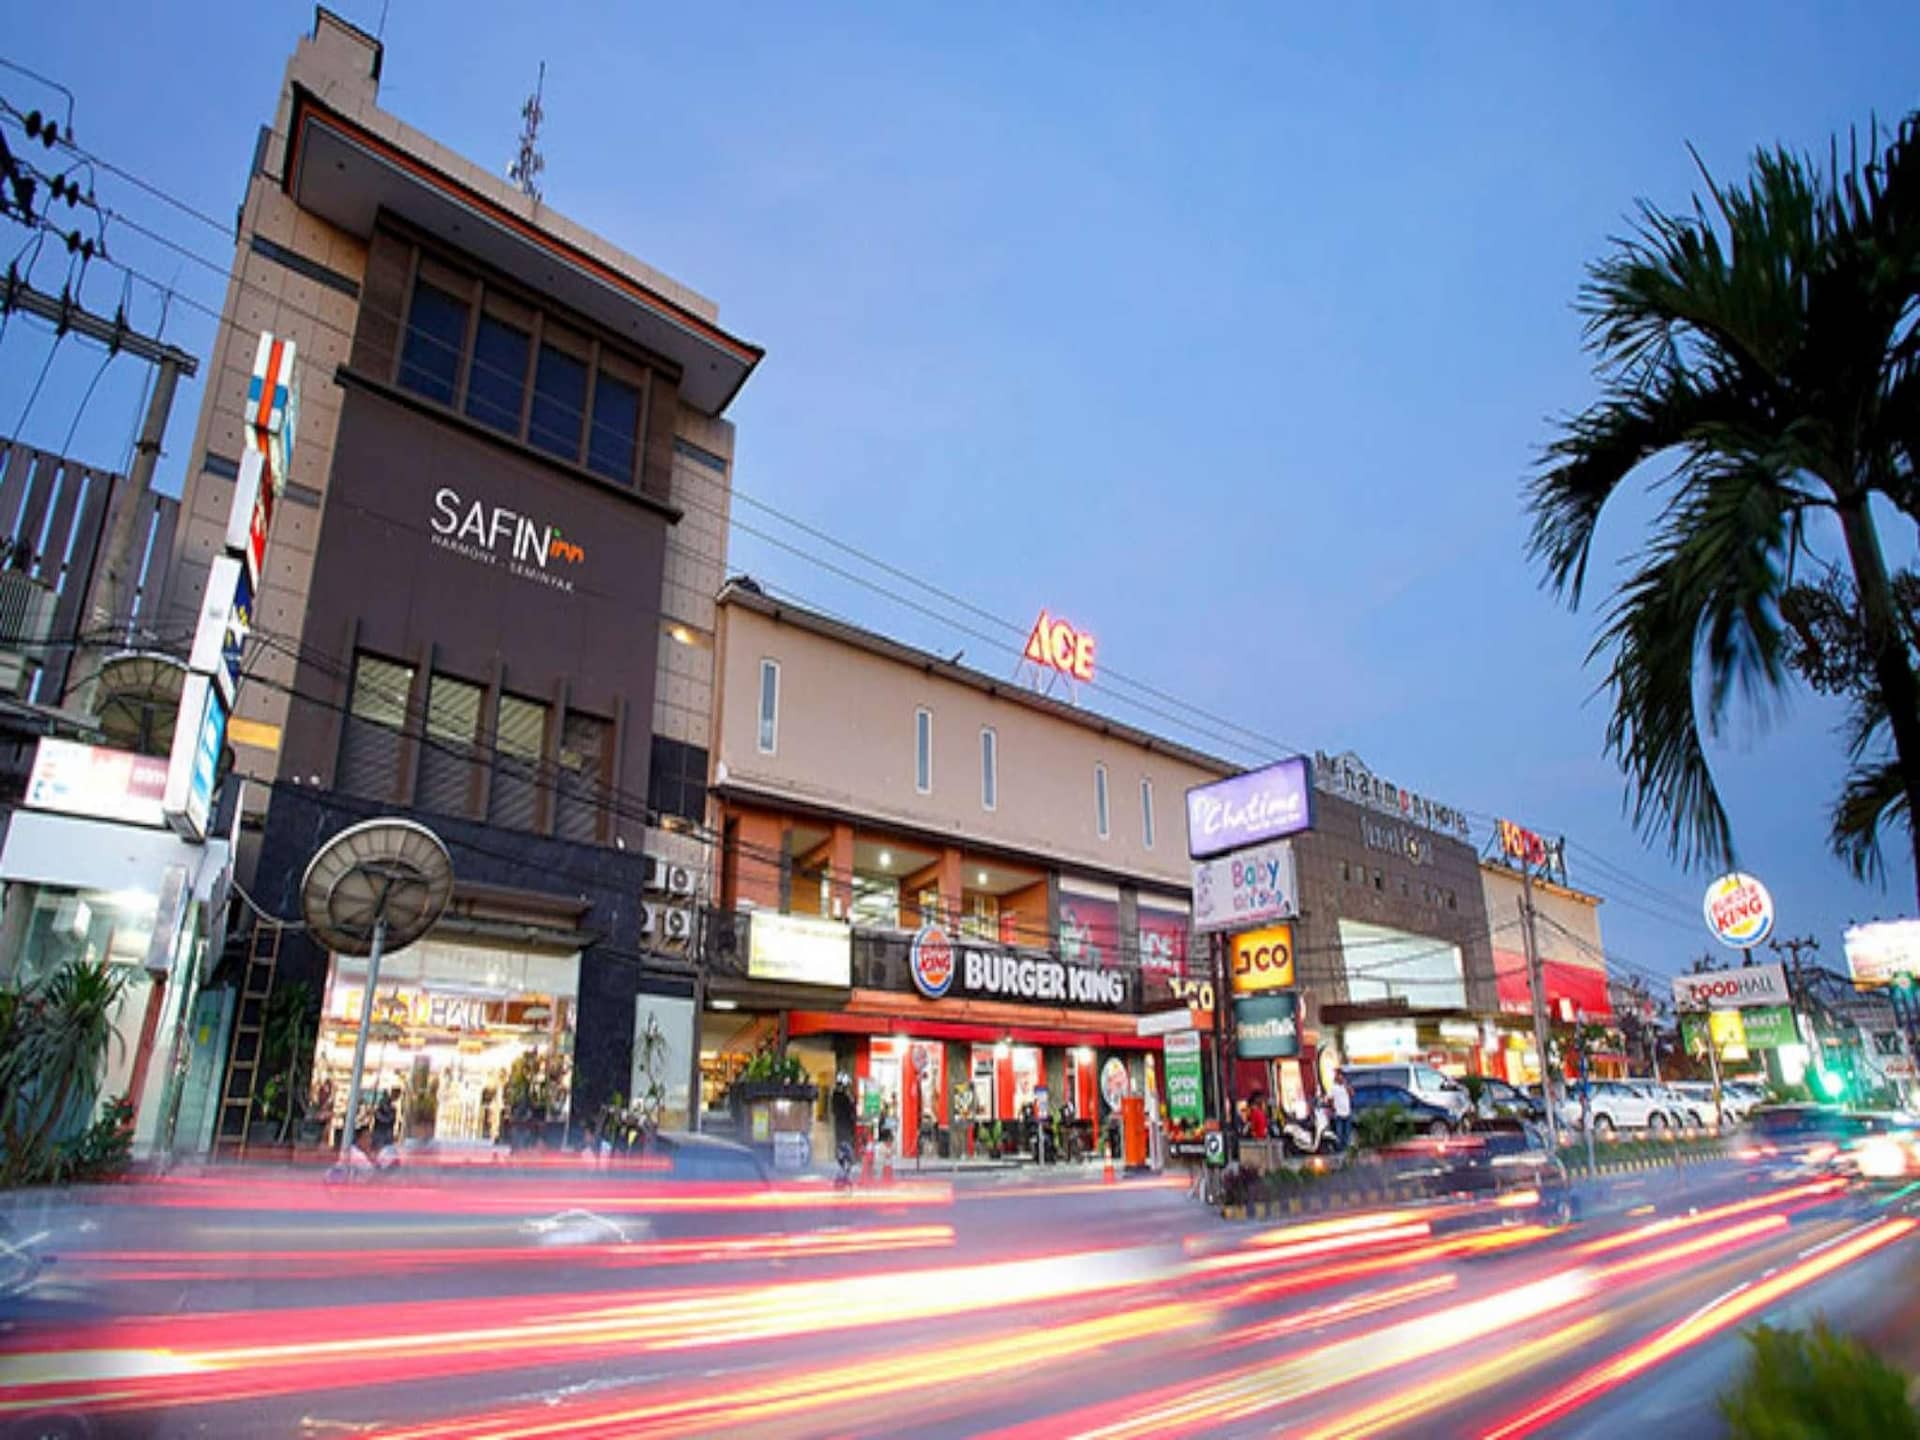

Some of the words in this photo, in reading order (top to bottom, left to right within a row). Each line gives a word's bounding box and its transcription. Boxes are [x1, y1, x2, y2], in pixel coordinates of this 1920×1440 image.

[430, 487, 552, 568] SAFIN
[1024, 608, 1096, 682] ACE
[1717, 894, 1763, 932] KING
[964, 951, 1066, 998] BURGER
[1069, 967, 1124, 1003] KING
